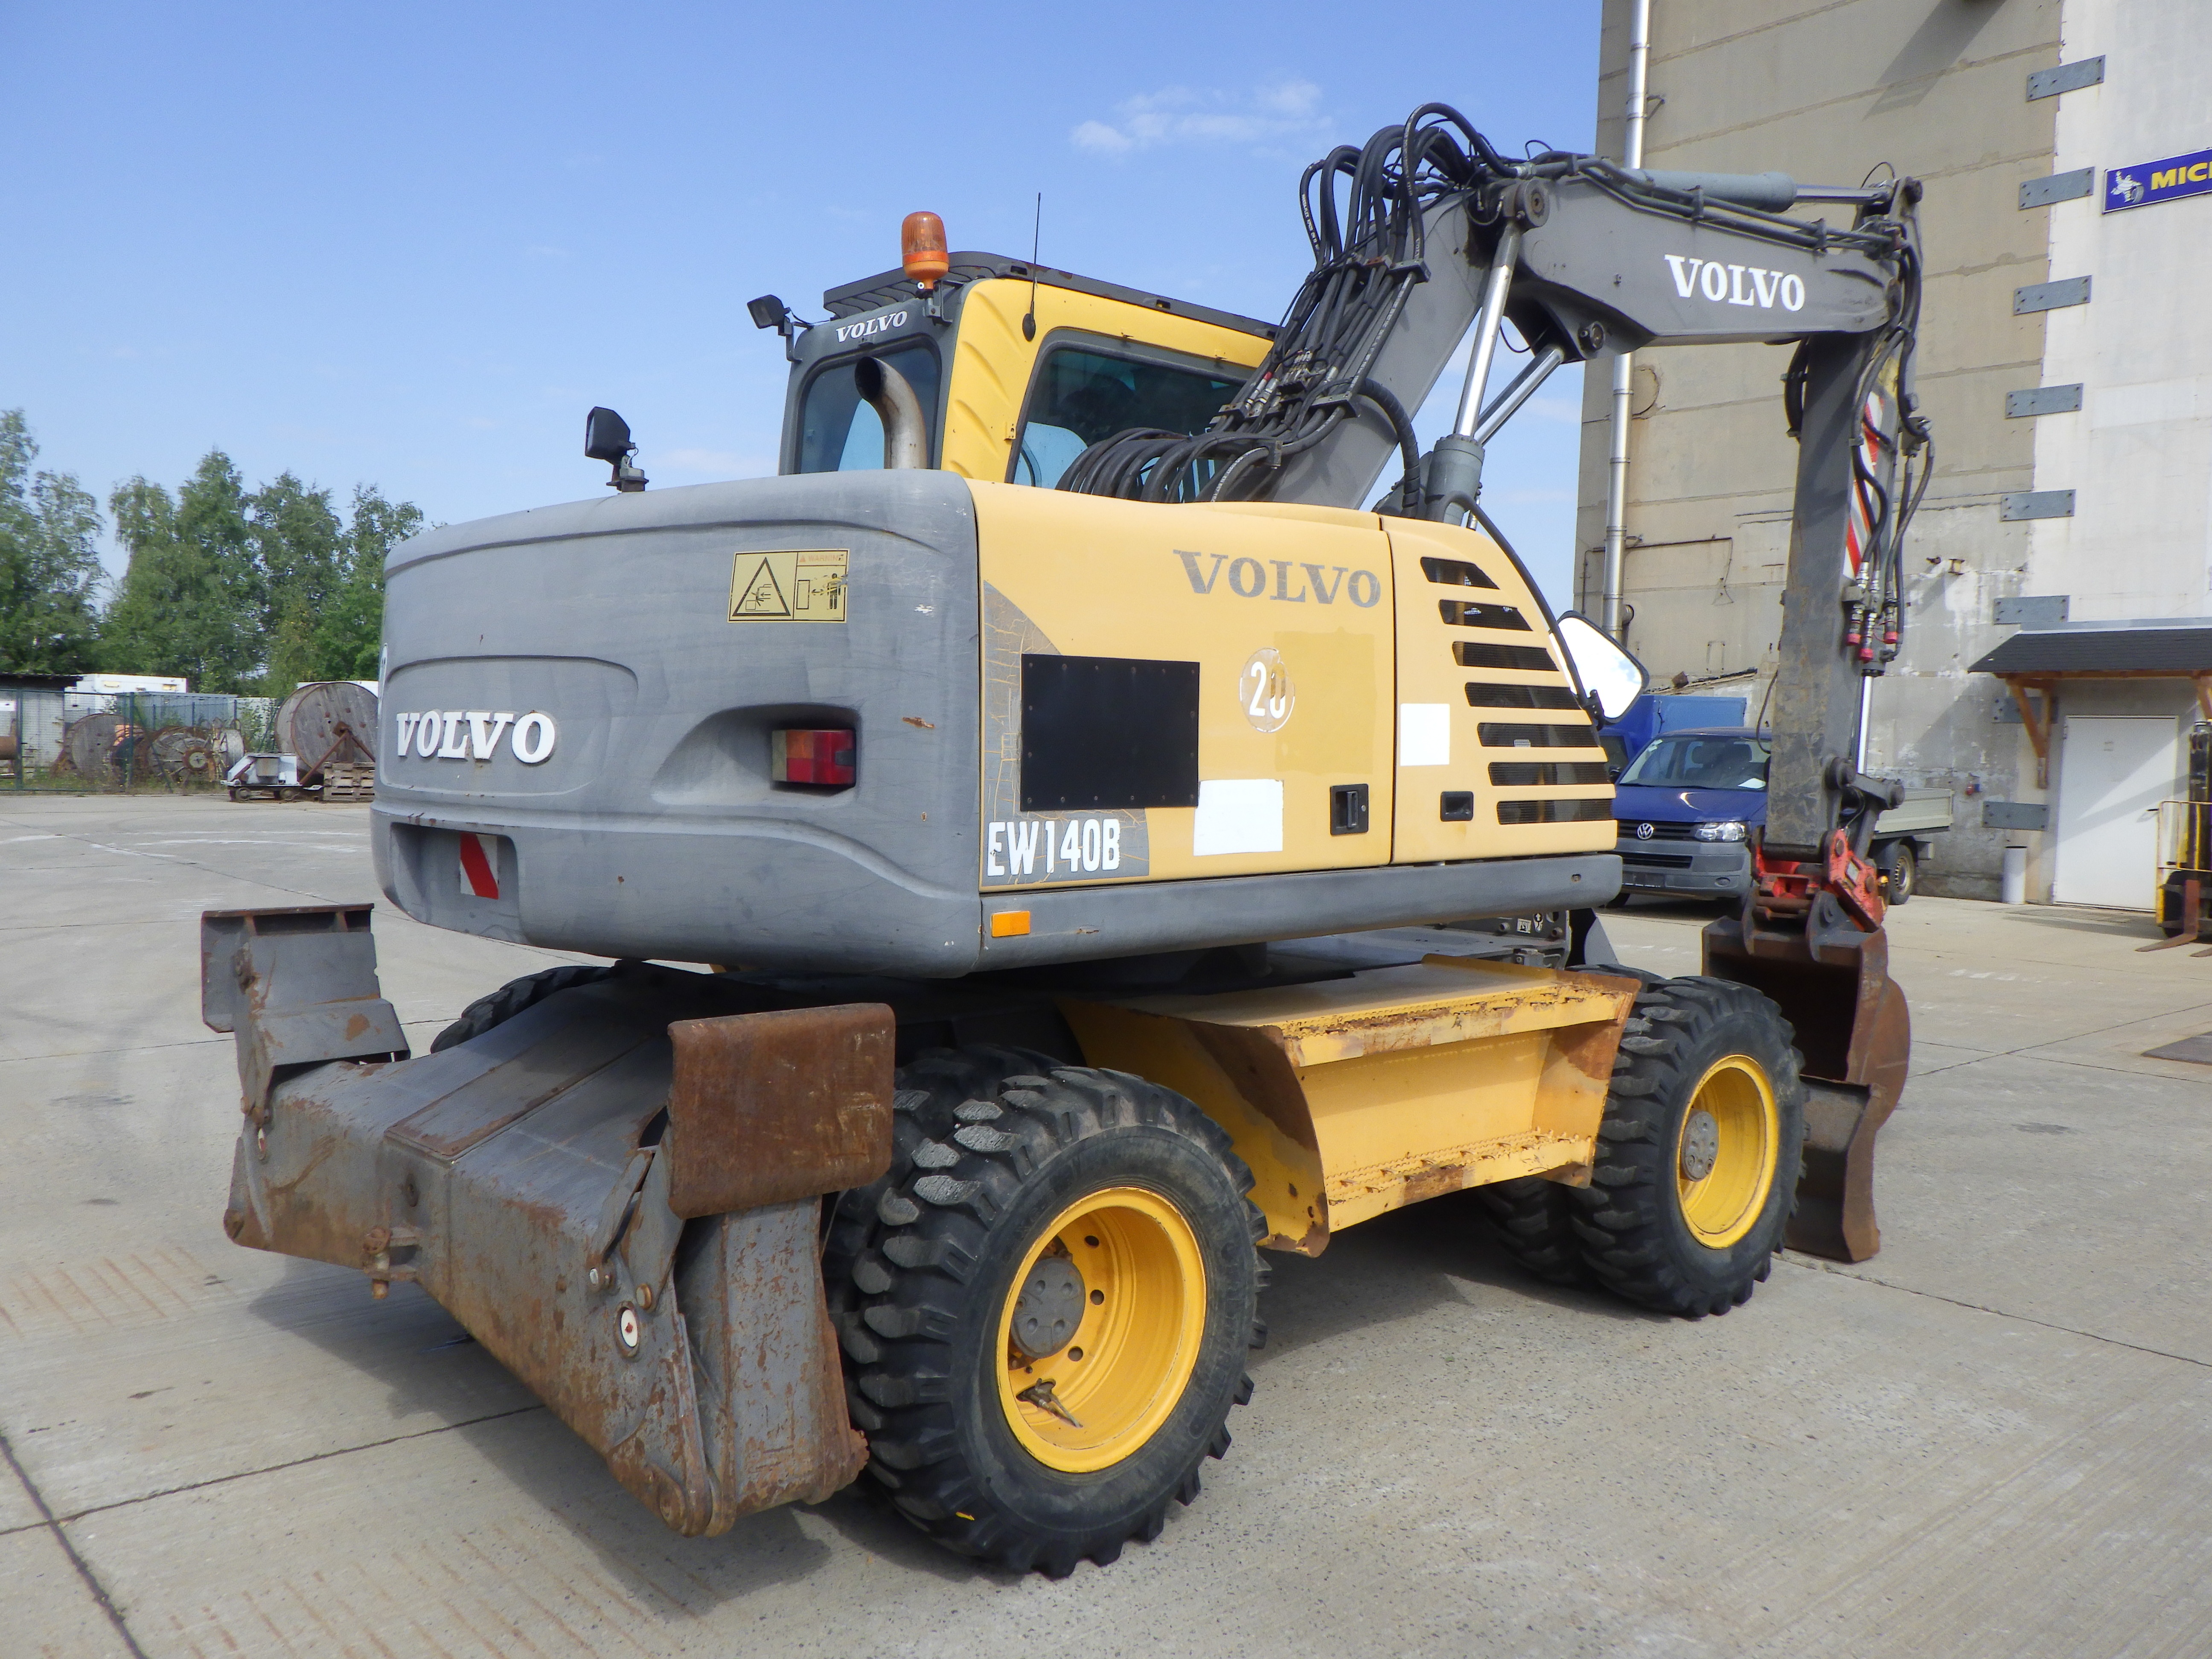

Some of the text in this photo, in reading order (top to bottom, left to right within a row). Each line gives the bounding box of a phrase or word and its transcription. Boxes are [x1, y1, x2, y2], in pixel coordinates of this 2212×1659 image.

[1664, 254, 1805, 311] VOLVO
[836, 311, 908, 343] VOLVO
[1173, 549, 1381, 608] VOLVO
[1249, 661, 1286, 719] 20
[396, 710, 556, 764] VOLVO
[987, 819, 1120, 876] EW140B
